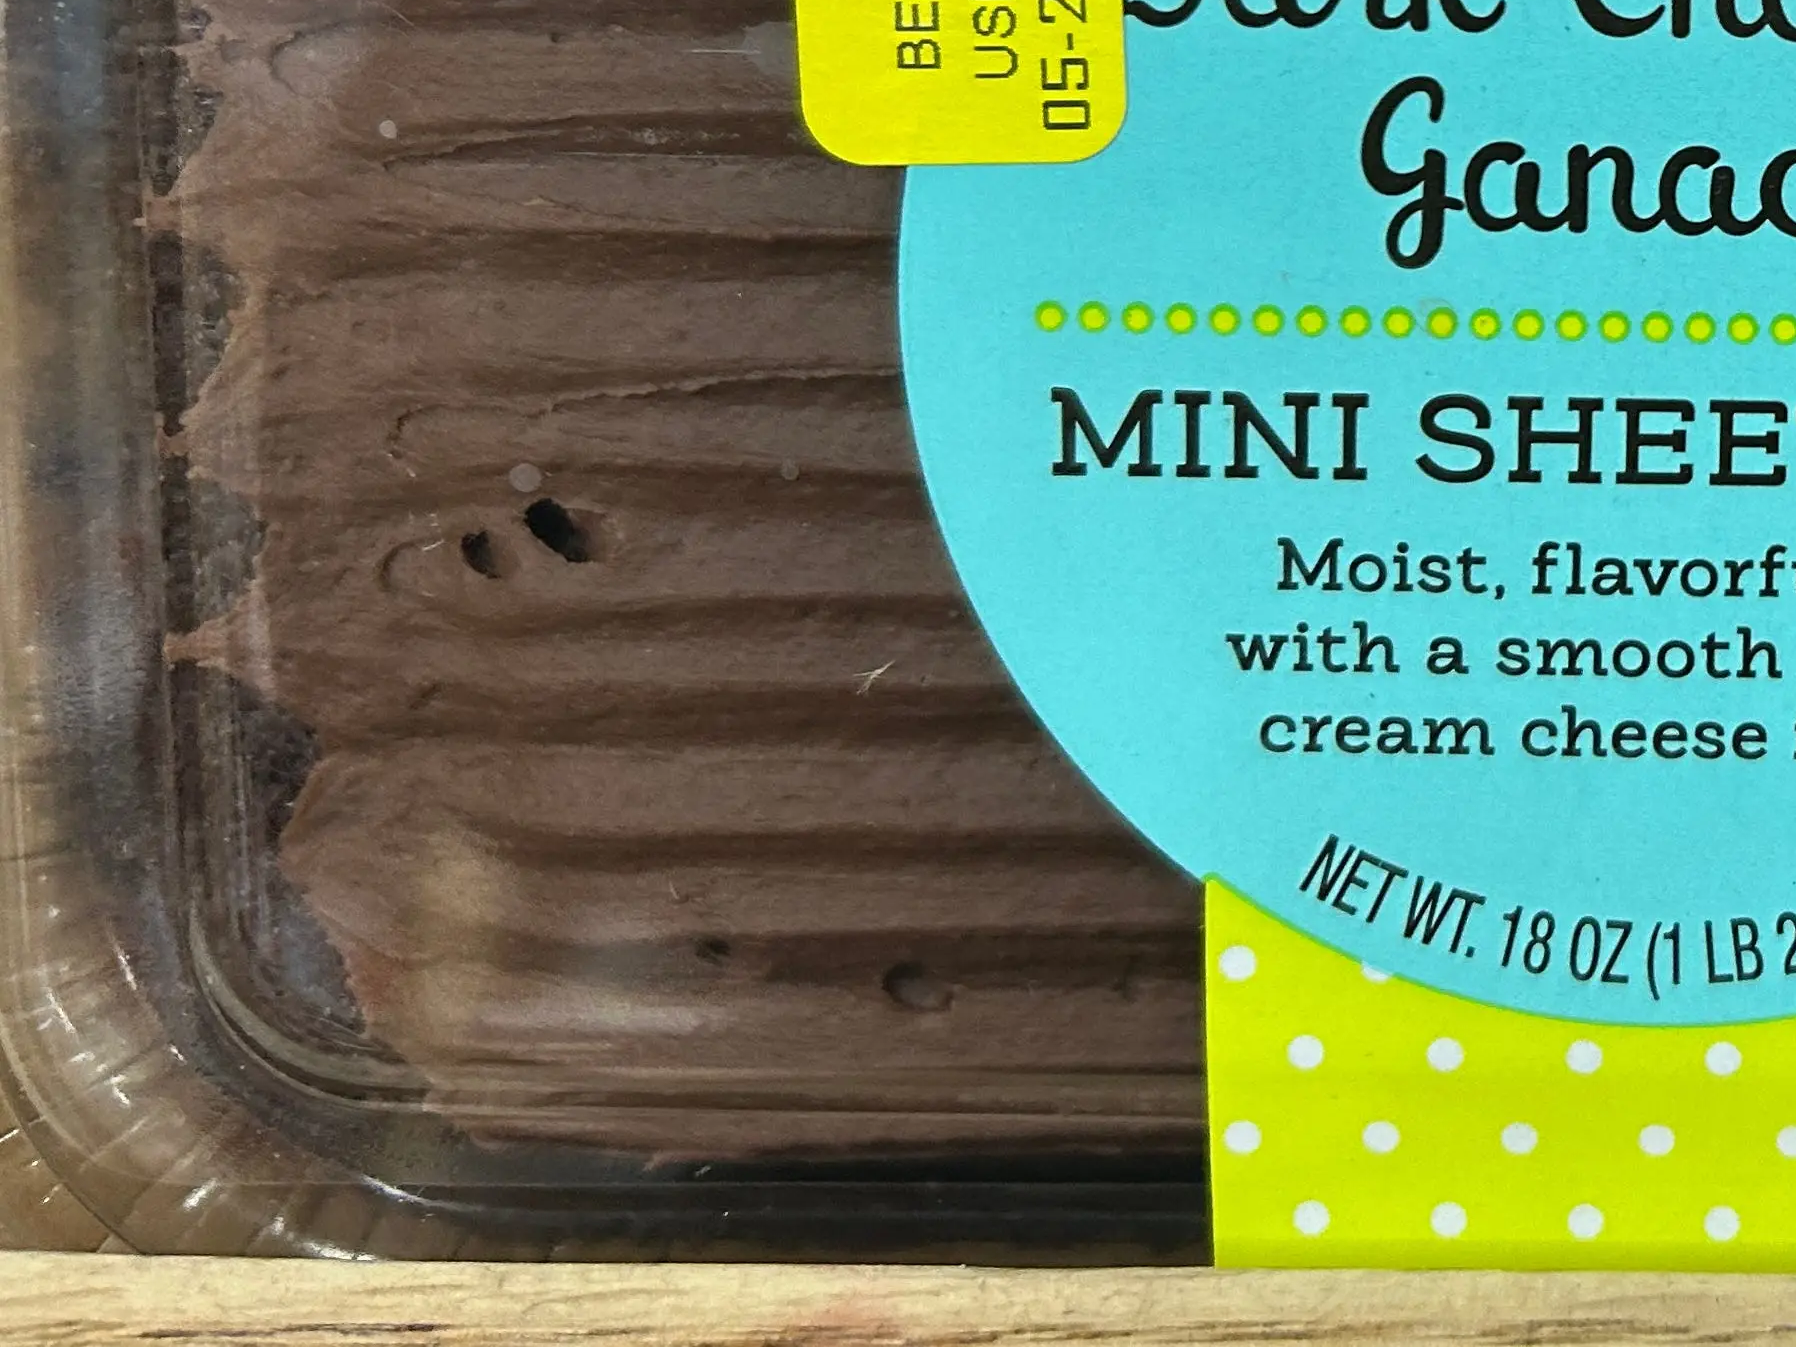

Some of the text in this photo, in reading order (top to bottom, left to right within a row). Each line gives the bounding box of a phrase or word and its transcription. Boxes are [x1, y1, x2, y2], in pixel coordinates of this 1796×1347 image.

[1051, 387, 1369, 480] MINI
[1278, 538, 1504, 599] Moist,
[1226, 621, 1400, 673] with
[1427, 637, 1468, 674] a
[1497, 627, 1782, 678] smooth
[1261, 716, 1494, 755] cream
[1522, 705, 1767, 759] cheese
[1299, 833, 1410, 924] NET
[1403, 873, 1487, 958] WT.
[1500, 905, 1556, 974] 18
[1569, 915, 1634, 985] OZ
[1644, 920, 1682, 1000] (1
[1703, 916, 1765, 984] LB
